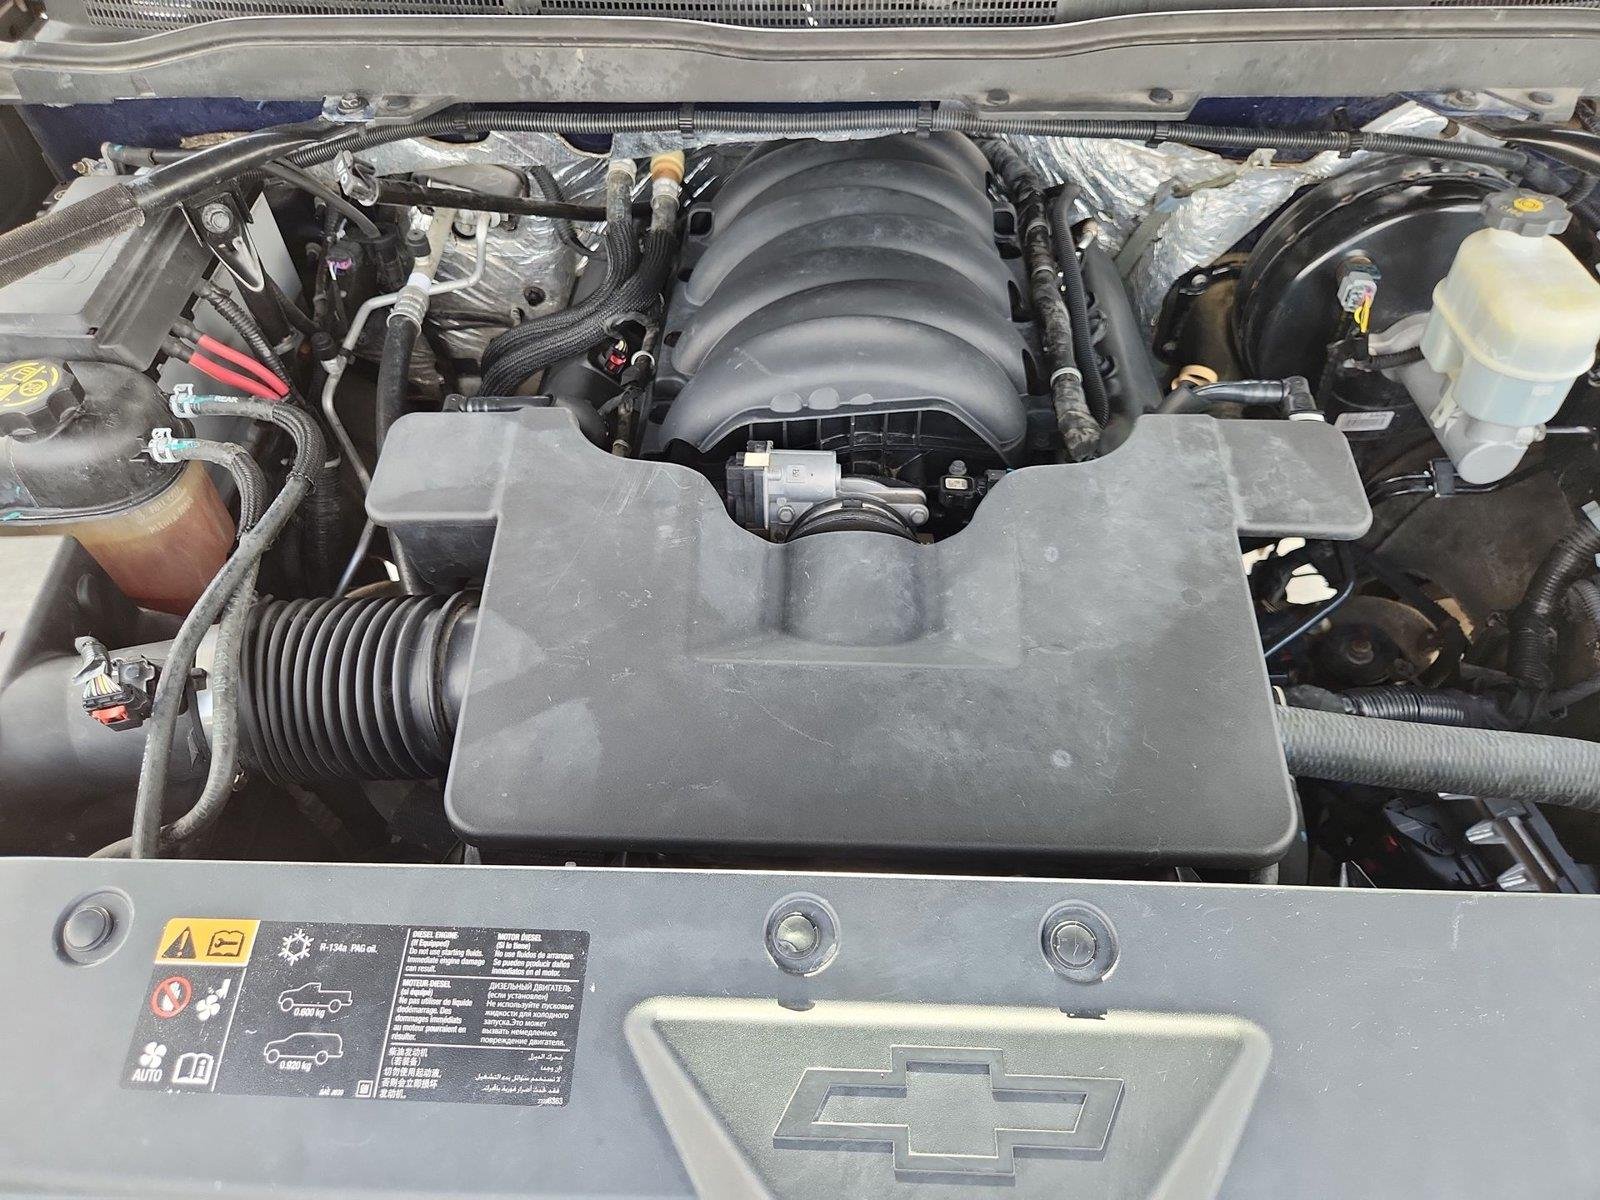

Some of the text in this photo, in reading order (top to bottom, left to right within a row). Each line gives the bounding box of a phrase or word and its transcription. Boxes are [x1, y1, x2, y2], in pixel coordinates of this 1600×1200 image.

[412, 930, 459, 939] DIESEL ENGINE
[498, 933, 520, 941] MOTOR
[319, 943, 347, 952] R-134a
[350, 944, 366, 952] PAG
[440, 957, 460, 965] engine
[461, 958, 486, 966] damage
[546, 953, 574, 961] arranque.
[493, 958, 502, 966] Se
[502, 959, 525, 967] pueden
[525, 960, 551, 968] producir
[402, 979, 451, 988] MOTEUR DIESEL
[489, 982, 571, 992] ДИЗЕЛЬНЫЙ ДВИГАТЕЛЬ
[487, 991, 549, 1001] (если установлен)
[398, 996, 408, 1004] Ne
[442, 998, 451, 1006] de
[497, 1001, 540, 1010] используйте
[315, 1008, 325, 1018] kg
[395, 1014, 429, 1024] dommages
[402, 1024, 425, 1032] moteur
[425, 1025, 458, 1033] pourraient
[511, 1029, 558, 1037] немедленное
[480, 1037, 528, 1045] повреждение
[280, 1060, 312, 1072] 0.920 kg
[131, 1068, 163, 1082] AUTO
